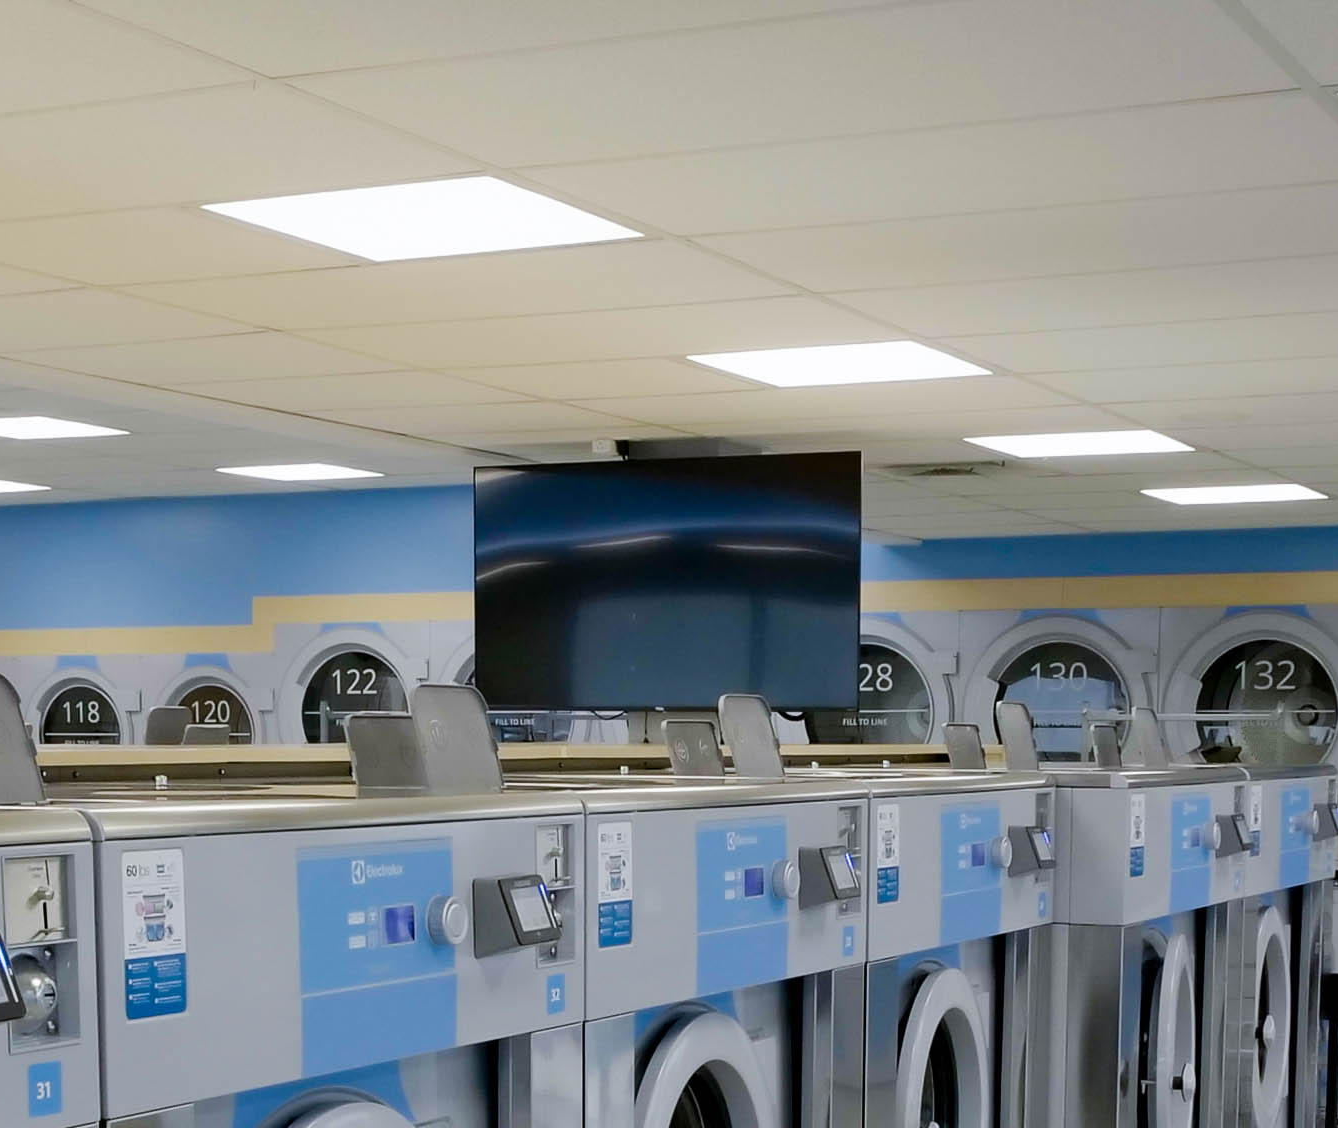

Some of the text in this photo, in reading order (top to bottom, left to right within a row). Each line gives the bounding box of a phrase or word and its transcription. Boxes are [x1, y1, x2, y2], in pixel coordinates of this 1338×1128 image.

[332, 668, 378, 695] 122
[859, 663, 893, 692] 28
[1030, 662, 1088, 691] 130
[1235, 660, 1296, 690] 132
[63, 701, 100, 724] 118
[191, 700, 230, 723] 120
[37, 1081, 51, 1100] 31
